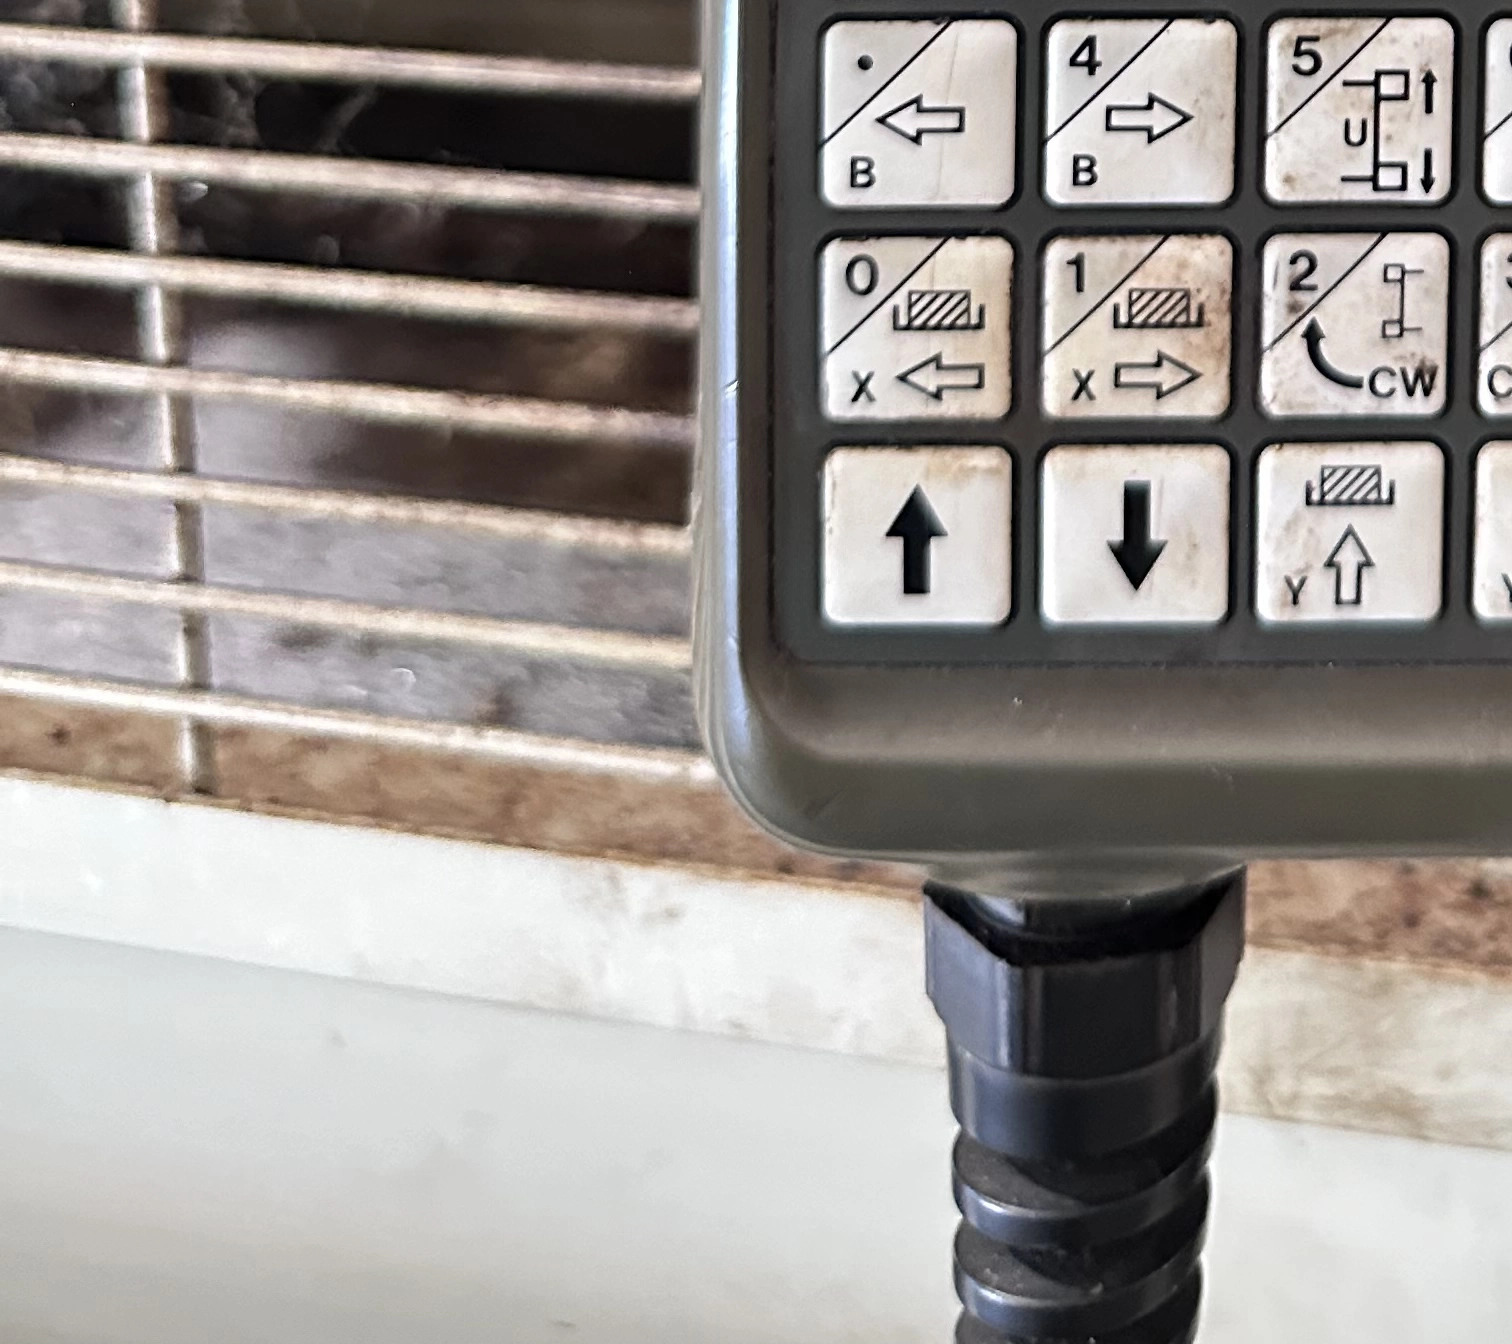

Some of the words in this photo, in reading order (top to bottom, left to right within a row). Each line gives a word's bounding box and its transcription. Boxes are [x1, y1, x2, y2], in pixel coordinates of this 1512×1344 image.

[1069, 35, 1102, 76] 4
[1291, 35, 1322, 76] 5
[1343, 118, 1367, 147] U
[850, 155, 876, 188] B
[1072, 154, 1098, 186] B
[845, 254, 879, 296] 0
[1066, 252, 1086, 293] 1
[1289, 249, 1318, 291] 2
[851, 370, 876, 402] X
[1071, 368, 1096, 401] X
[1368, 365, 1438, 399] CW
[1285, 575, 1308, 605] Y
